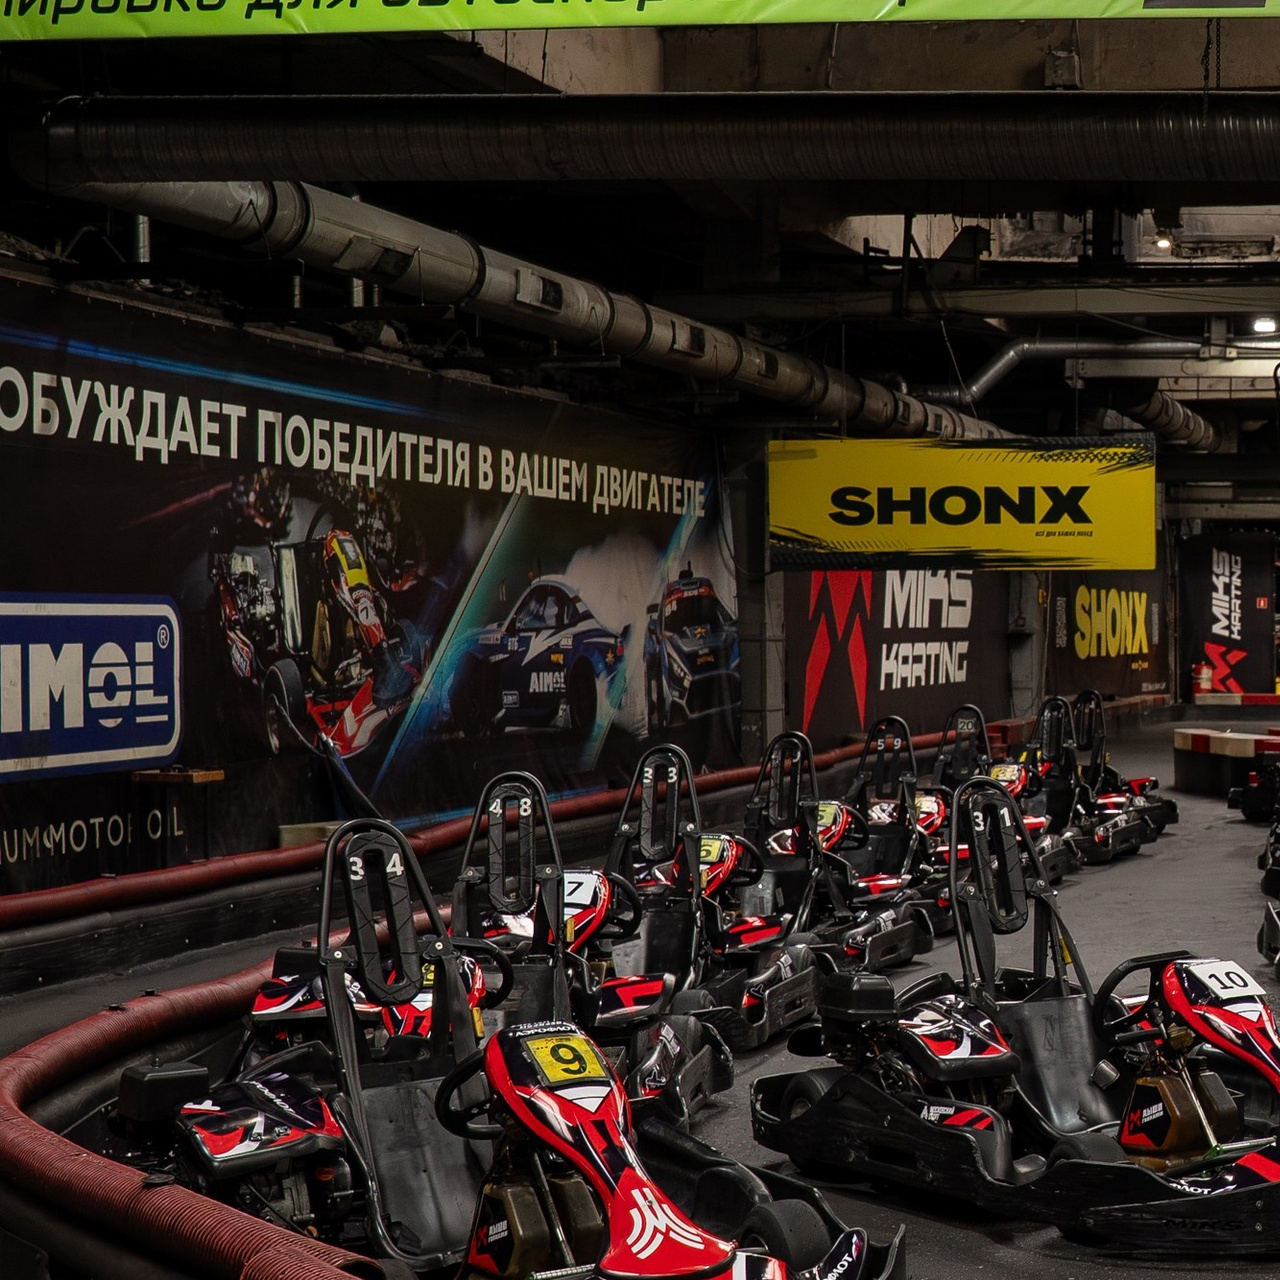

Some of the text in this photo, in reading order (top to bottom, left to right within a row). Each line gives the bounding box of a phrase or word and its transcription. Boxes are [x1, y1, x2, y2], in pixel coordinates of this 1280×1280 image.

[0, 366, 706, 518] ОБУЖДАЕТ ПОБЕДИТЕЛЯ В ВАШЕМ ДВИГАТЕЛЕ
[828, 485, 1093, 527] SHONX
[883, 569, 973, 629] MIKS
[1211, 547, 1230, 638] MIKS
[1230, 554, 1242, 641] KARTING
[1074, 585, 1149, 660] SHONX
[0, 642, 169, 733] IMOL
[879, 641, 969, 691] KARTING
[959, 720, 975, 733] 20
[566, 881, 585, 897] 7
[1207, 970, 1250, 991] 10
[549, 1043, 588, 1076] 9
